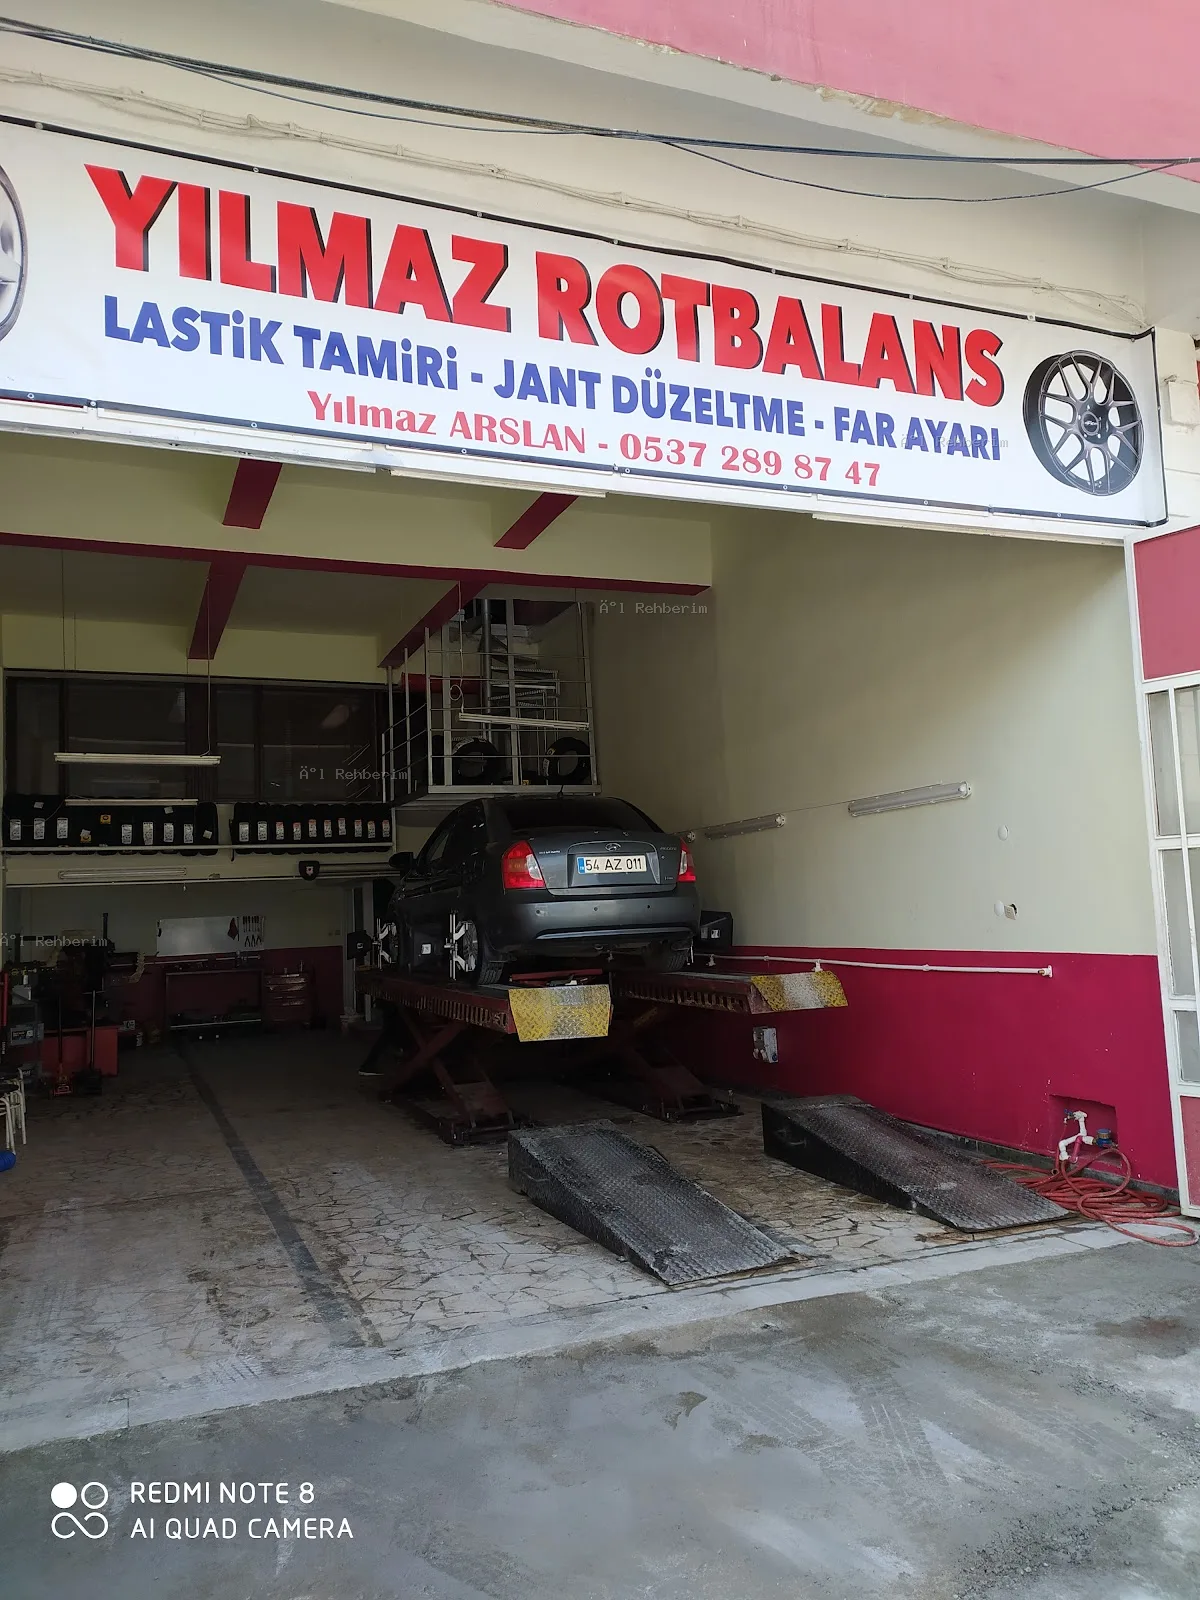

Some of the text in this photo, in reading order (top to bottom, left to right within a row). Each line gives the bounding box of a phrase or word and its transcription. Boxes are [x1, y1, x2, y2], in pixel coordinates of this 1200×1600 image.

[83, 164, 1004, 408] YILMAZ ROTBALANS
[307, 390, 437, 435] Yılmaz
[449, 411, 585, 453] ARSLAN
[619, 433, 707, 467] 0537
[721, 445, 782, 476] 289
[794, 454, 832, 482] 87
[844, 461, 881, 487] 47
[494, 359, 601, 410] JANT
[612, 367, 805, 435] DÜZELTME
[832, 407, 898, 449] FAR
[904, 416, 1001, 461] AYARI
[585, 859, 600, 871] 54
[604, 858, 623, 871] AZ
[626, 857, 642, 870] 011
